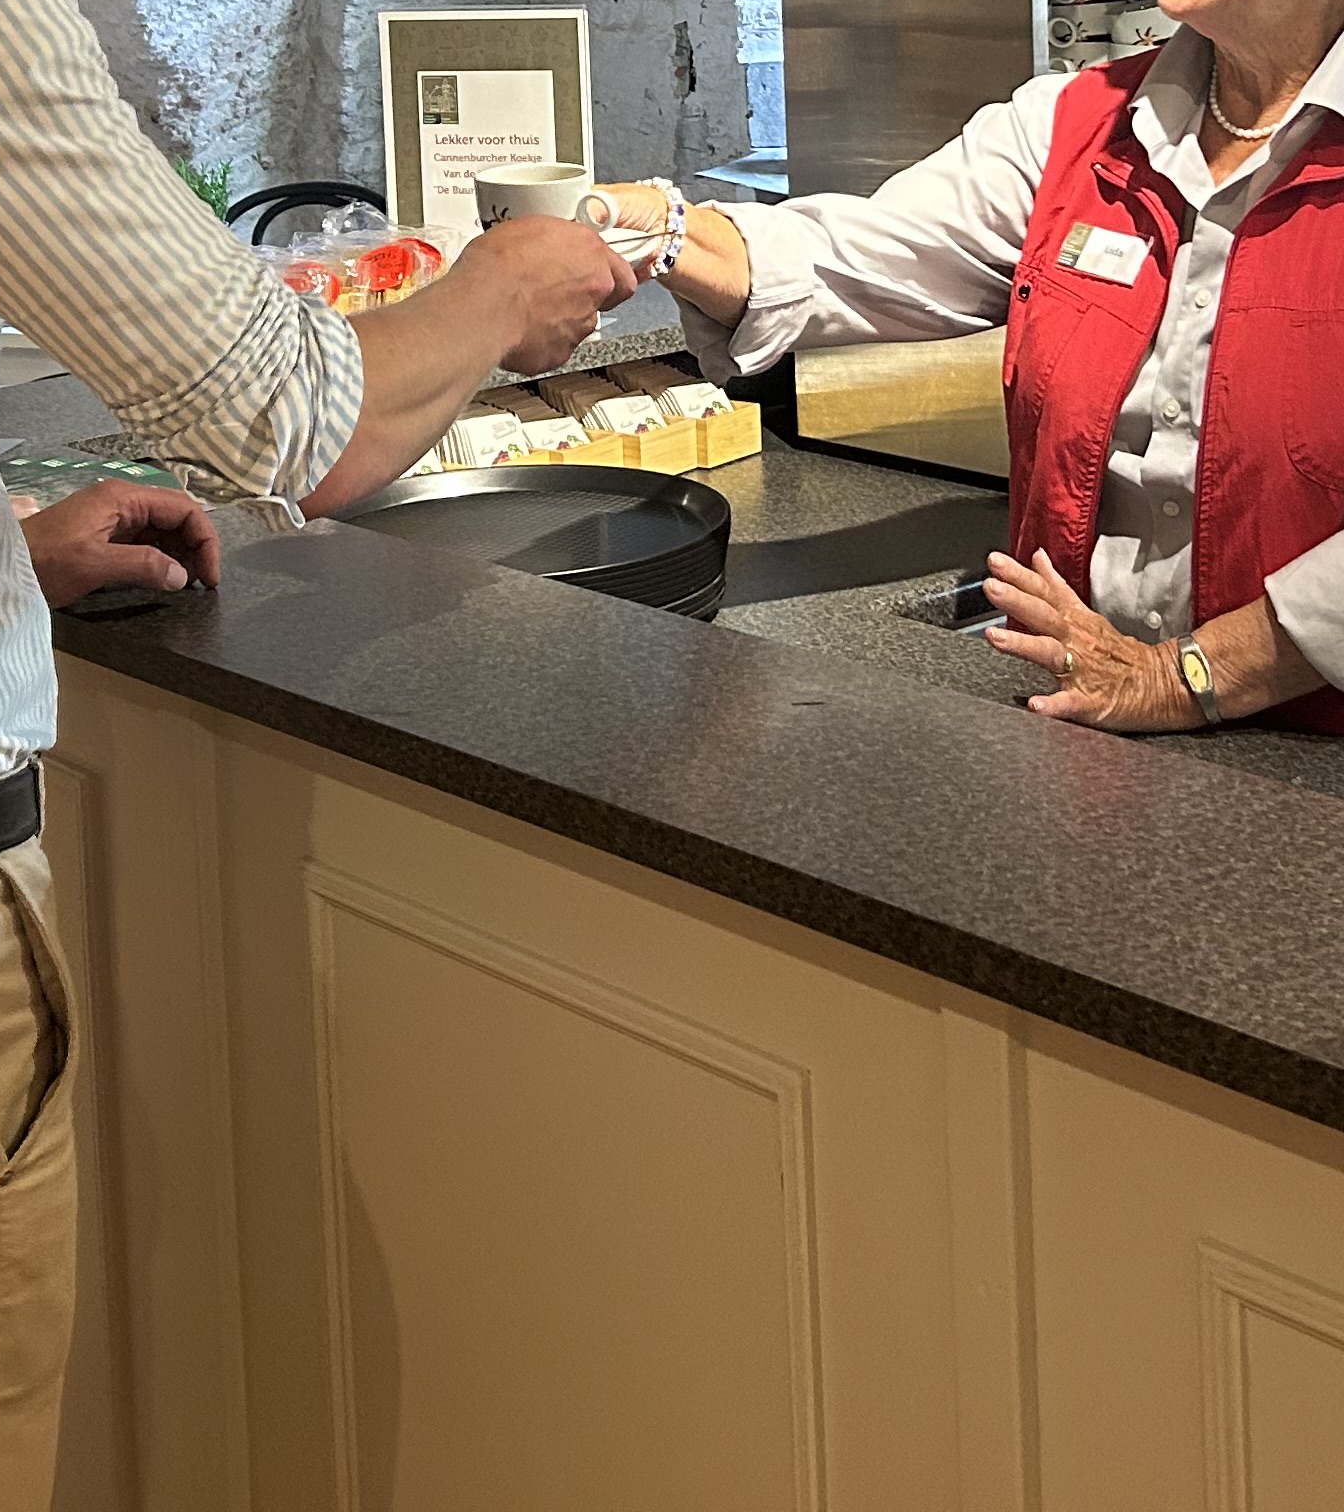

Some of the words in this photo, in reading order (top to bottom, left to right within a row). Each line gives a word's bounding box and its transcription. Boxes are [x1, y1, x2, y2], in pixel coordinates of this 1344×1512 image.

[434, 134, 474, 145] Lekker
[477, 136, 505, 145] voor
[509, 134, 540, 145] thuis
[434, 153, 508, 163] Cannenburcher
[510, 153, 543, 164] Koekje
[443, 169, 461, 178] Van
